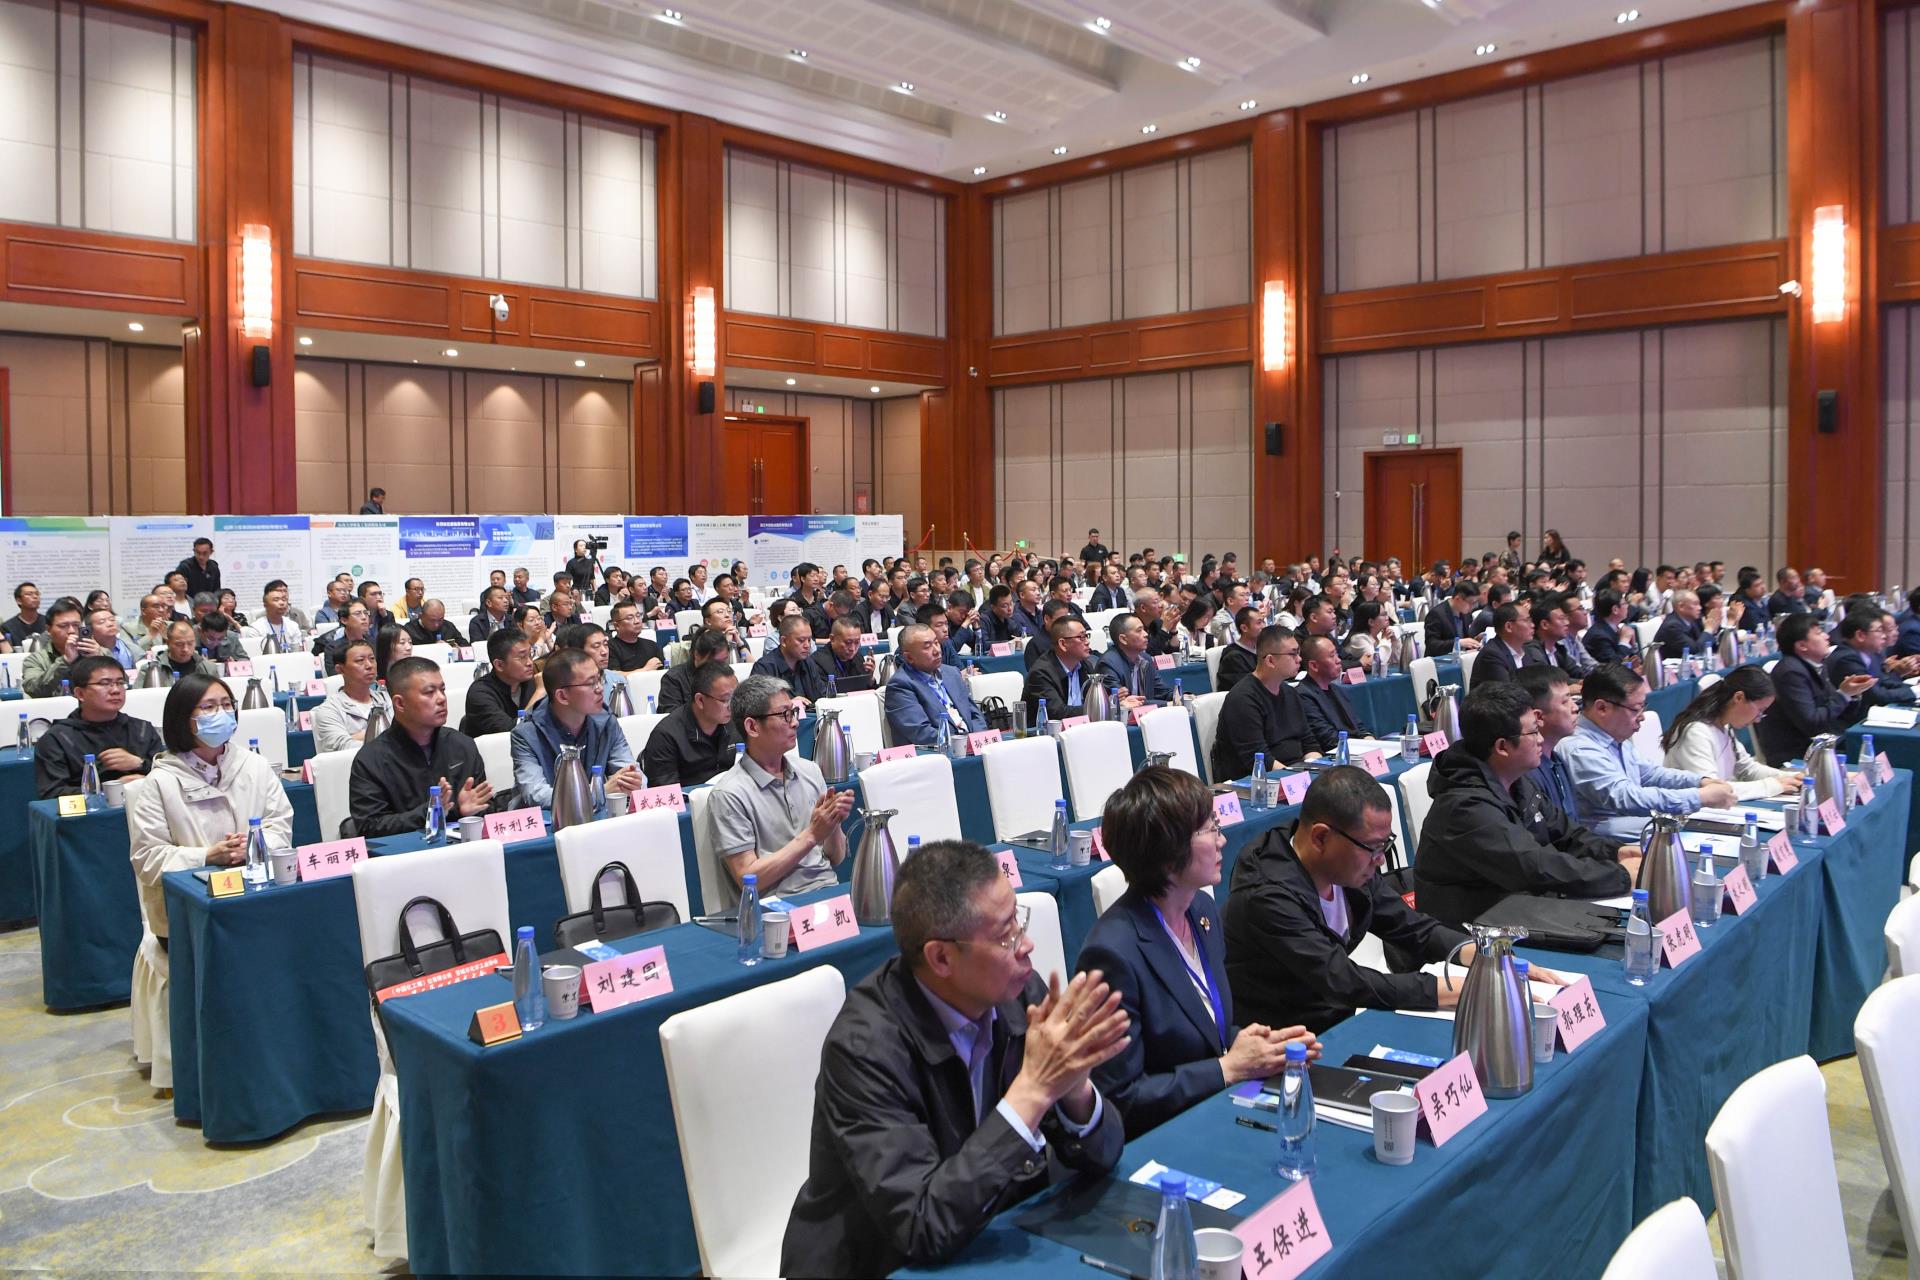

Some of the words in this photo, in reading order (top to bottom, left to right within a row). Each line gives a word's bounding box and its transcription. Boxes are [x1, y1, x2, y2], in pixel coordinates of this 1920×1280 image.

[306, 846, 360, 870] 车丽玮
[223, 875, 233, 888] 4
[801, 908, 851, 936] 王凯
[597, 961, 660, 994] 刘建国
[492, 1012, 507, 1032] 3
[1430, 1073, 1473, 1122] 吴巧仙
[1252, 1207, 1318, 1276] 王保进
